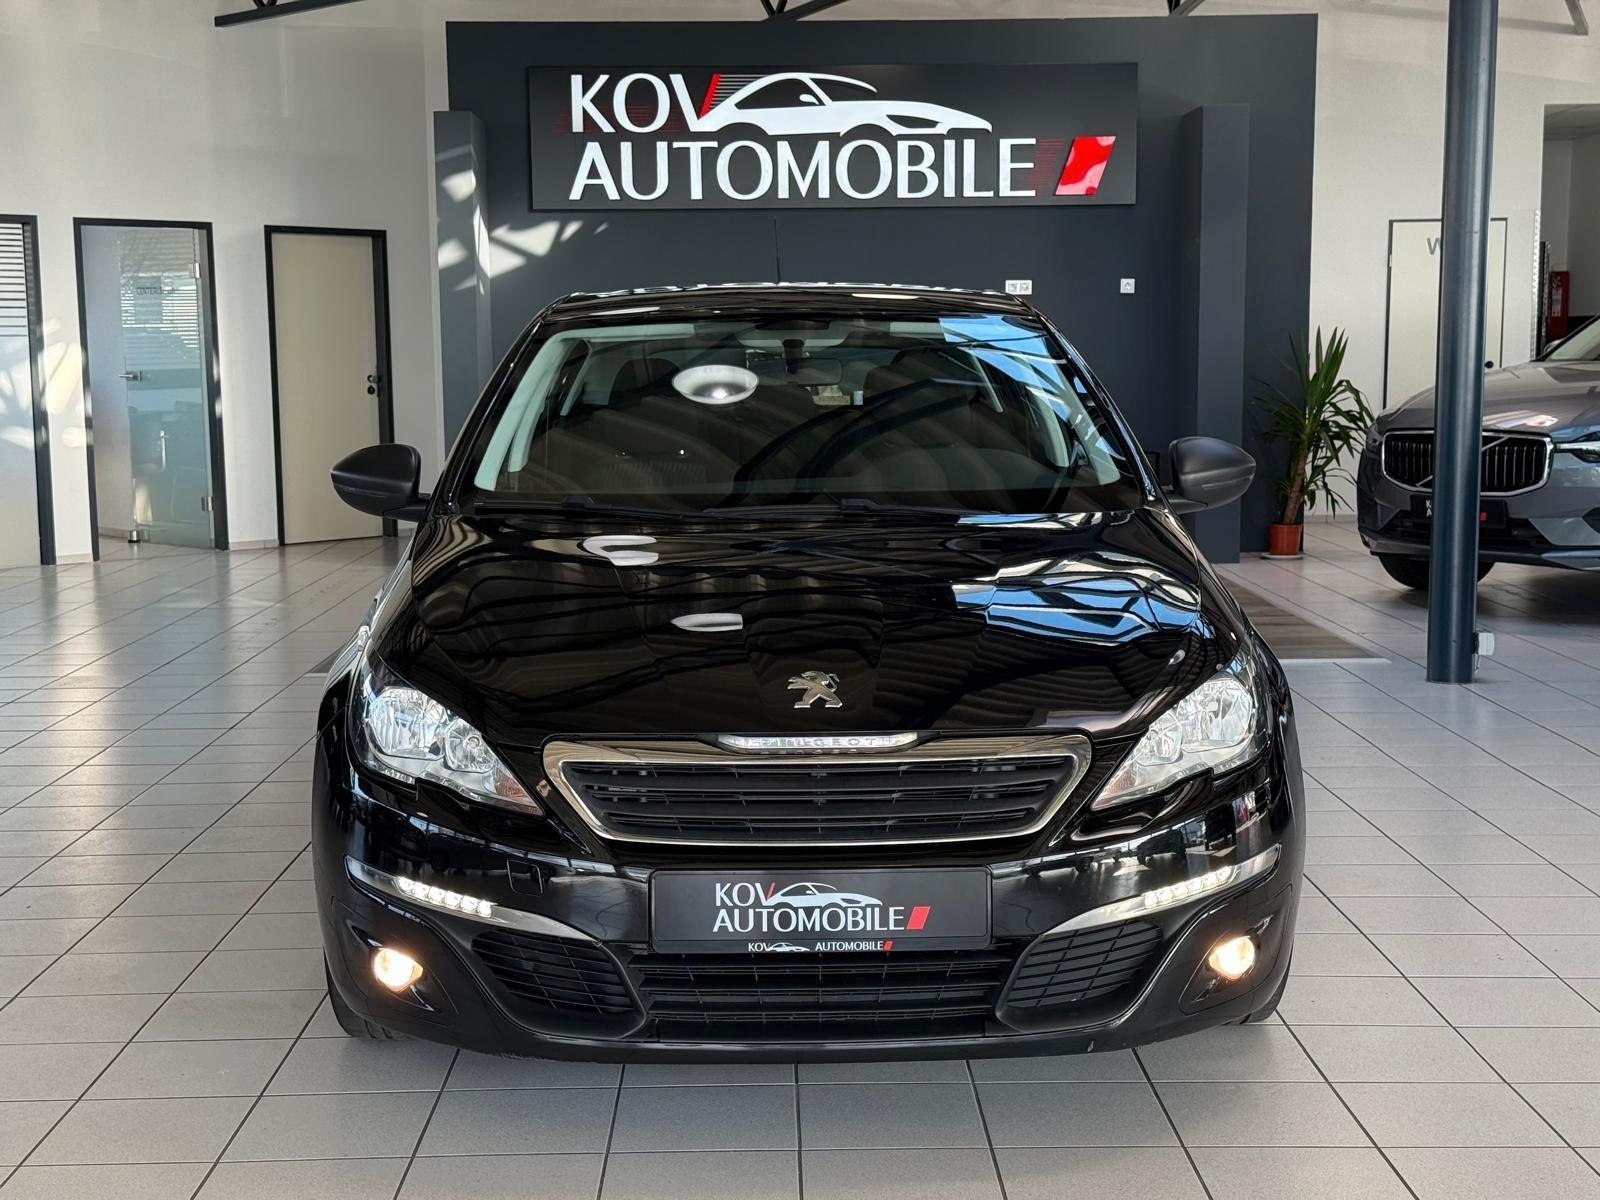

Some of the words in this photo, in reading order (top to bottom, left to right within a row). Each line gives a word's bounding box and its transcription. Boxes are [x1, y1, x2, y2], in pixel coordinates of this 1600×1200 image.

[570, 73, 721, 134] KOV
[568, 137, 1037, 201] AUTOMOBILE
[760, 737, 877, 747] UGEOT
[715, 882, 776, 907] KOV
[712, 906, 905, 932] AUTOMOBILE
[748, 942, 772, 952] KOV
[815, 940, 884, 952] AUTOMOBILE
